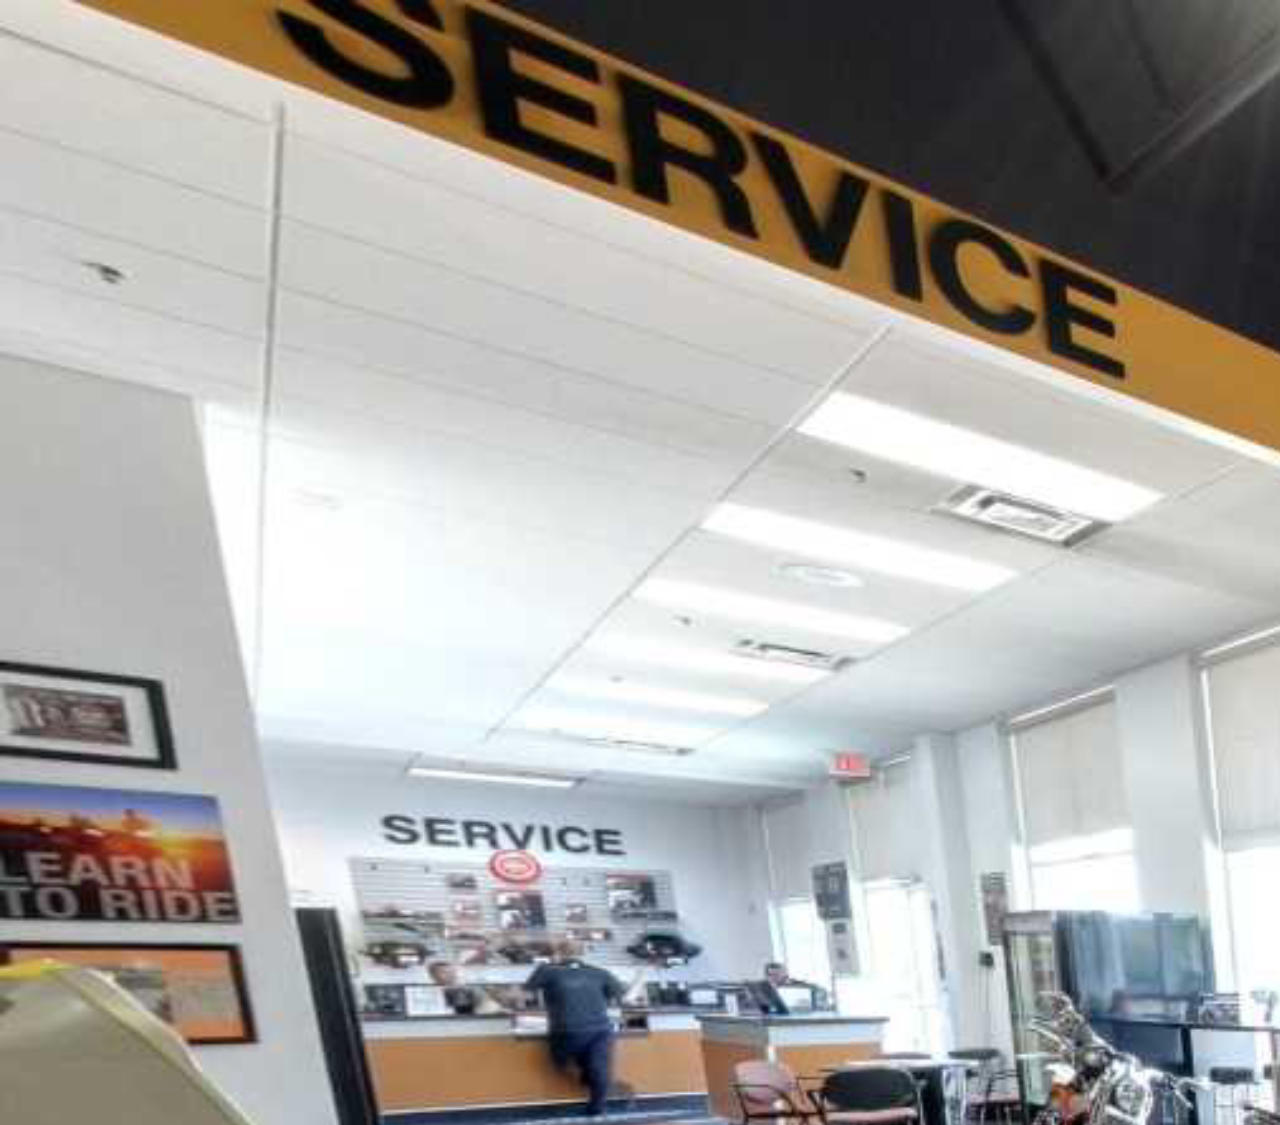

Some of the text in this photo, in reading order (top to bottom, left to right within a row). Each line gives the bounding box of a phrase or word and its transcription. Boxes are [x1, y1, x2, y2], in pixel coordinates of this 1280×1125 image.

[276, 0, 1126, 379] SERVICE
[381, 814, 627, 855] SERVICE
[0, 850, 195, 889] LEARN
[0, 884, 242, 923] TO RIDE
